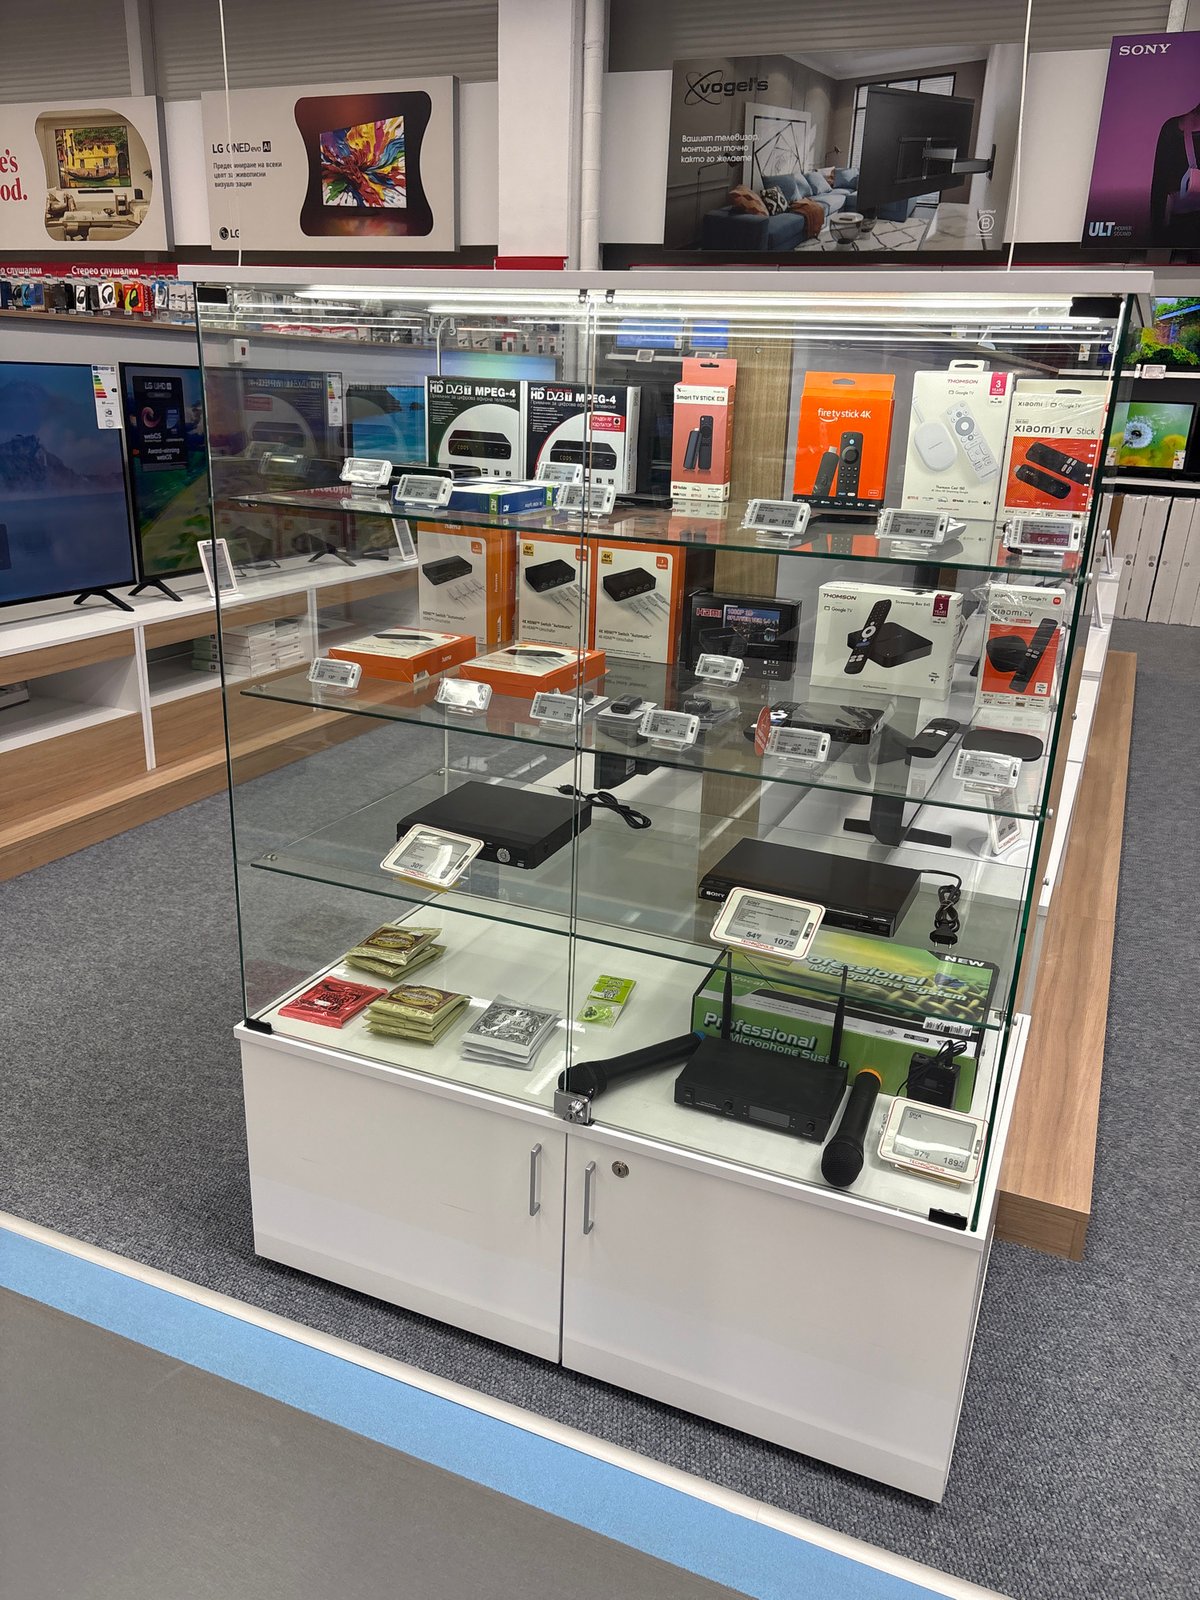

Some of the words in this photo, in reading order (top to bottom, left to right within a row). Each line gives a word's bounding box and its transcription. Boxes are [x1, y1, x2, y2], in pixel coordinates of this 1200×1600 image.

[1119, 43, 1171, 56] SONY
[700, 77, 769, 97] vogel's
[682, 134, 714, 143] Вашият
[212, 143, 224, 154] LG
[681, 146, 722, 154] монтиран
[681, 155, 705, 163] както
[716, 155, 752, 163] желаете
[0, 177, 28, 201] od.
[1089, 221, 1116, 237] ULT
[7, 267, 43, 275] слушалки
[72, 265, 98, 275] Стерео
[100, 267, 139, 278] слушалки
[429, 383, 444, 394] HD
[475, 386, 517, 398] MPEG-4
[995, 380, 1002, 388] 3
[531, 391, 545, 400] HD
[576, 393, 617, 404] MPEG-4
[818, 407, 832, 417] fire
[832, 410, 841, 418] tv
[841, 409, 860, 418] stick
[860, 410, 872, 419] 4K
[1059, 426, 1073, 435] TV
[1076, 427, 1096, 436] Stick
[823, 592, 857, 601] THOMSON
[706, 890, 725, 898] SONY
[944, 954, 985, 967] NEW
[806, 953, 929, 986] ofessional
[904, 983, 969, 1002] System
[730, 1032, 800, 1057] Microphone
[800, 1048, 848, 1068] Systm
